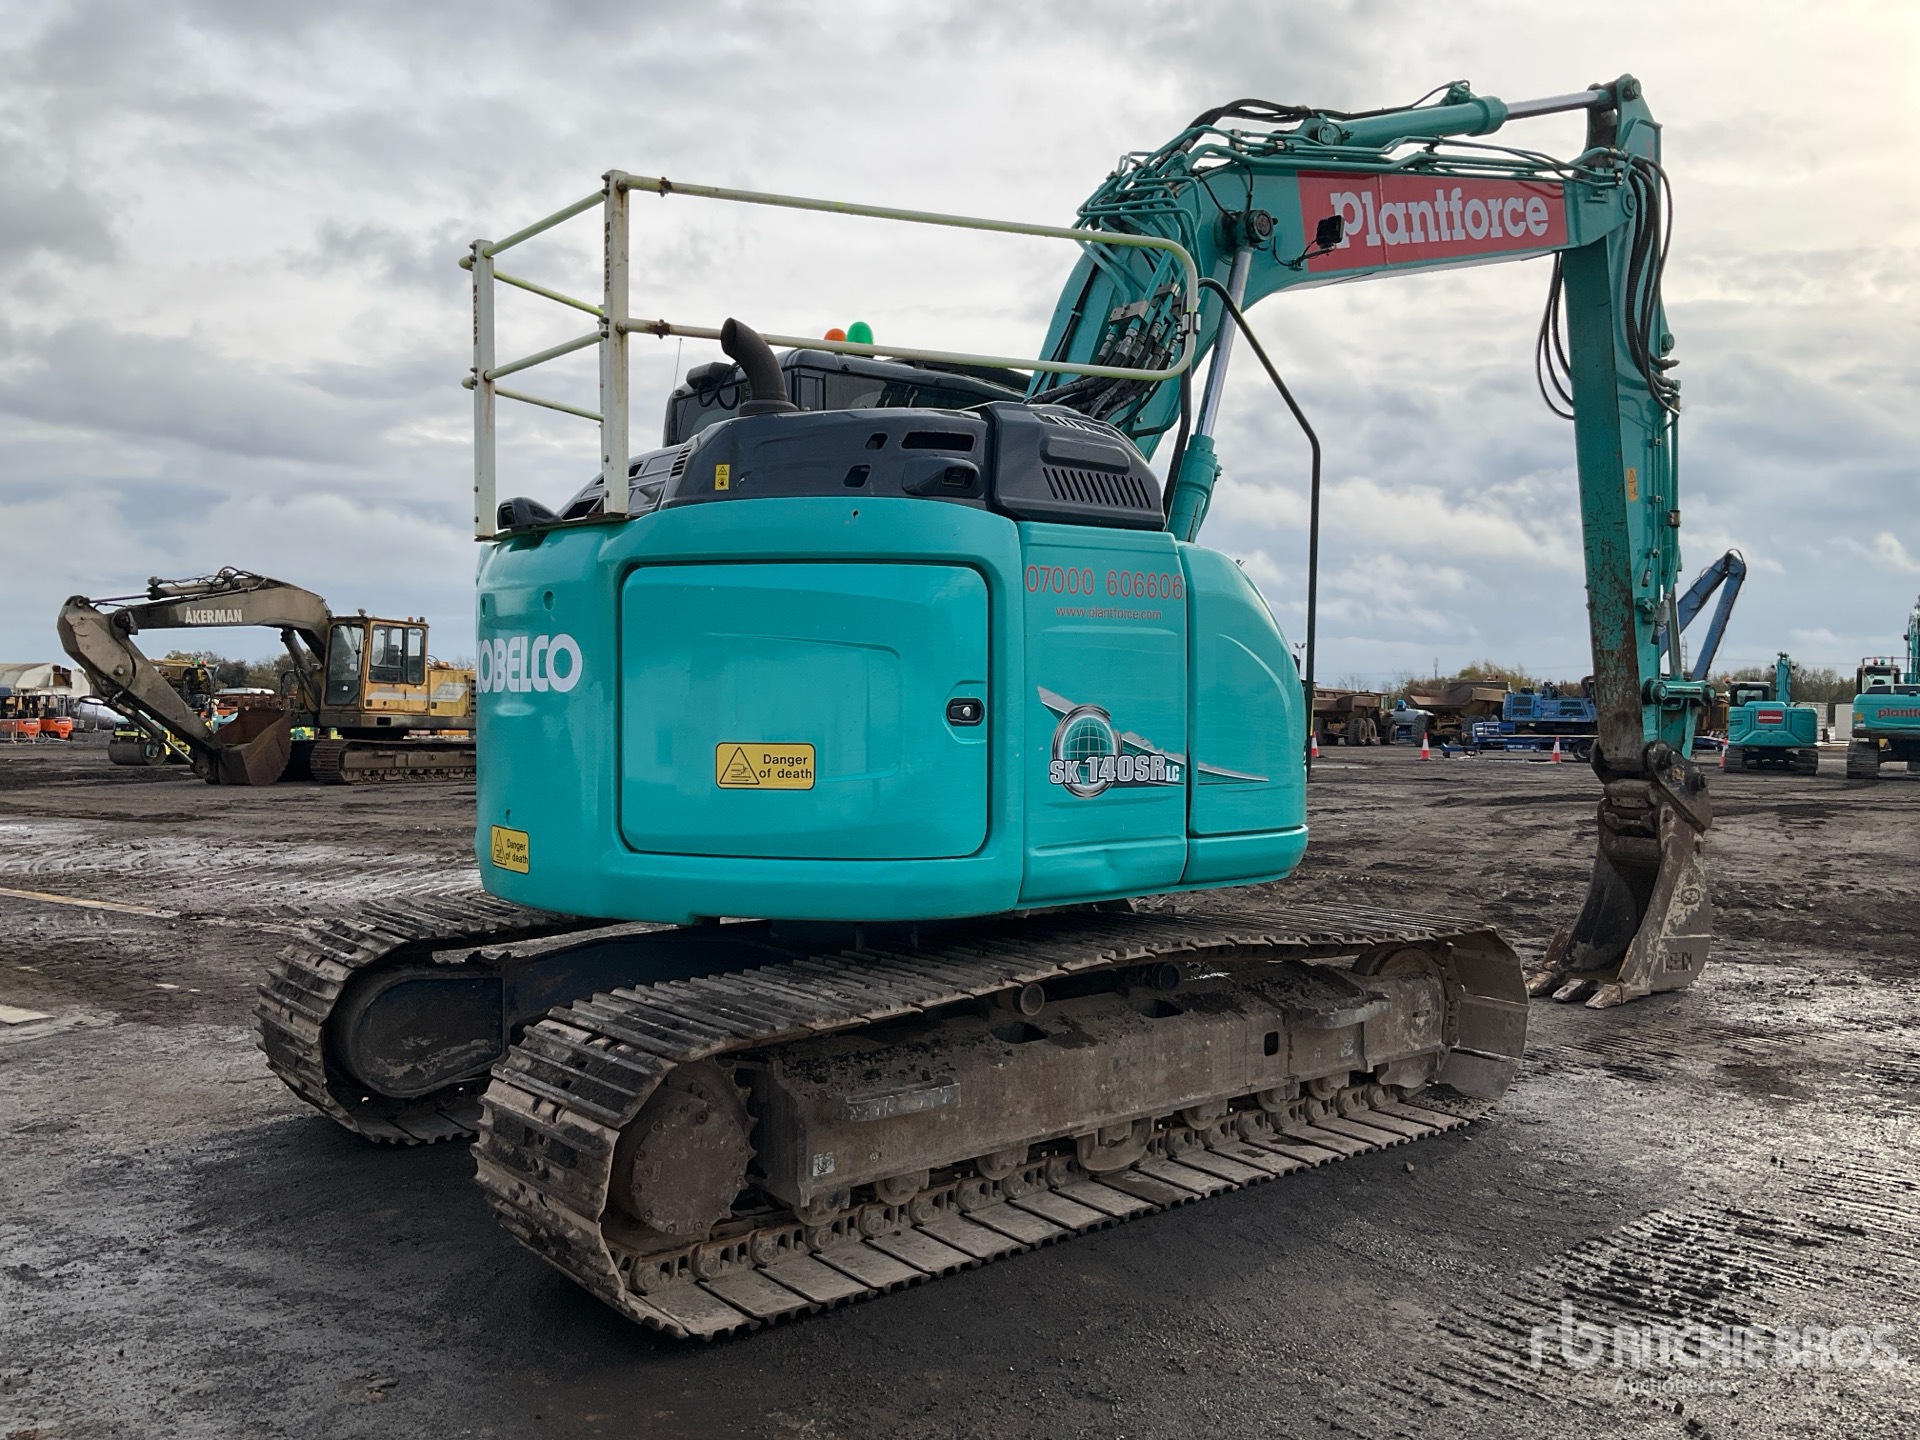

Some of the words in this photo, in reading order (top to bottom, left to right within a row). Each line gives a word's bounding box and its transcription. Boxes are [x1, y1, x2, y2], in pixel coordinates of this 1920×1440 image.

[1025, 565, 1095, 595] 07000
[1106, 570, 1184, 600] 606606
[184, 606, 243, 624] ÅKERMAN
[1055, 606, 1162, 620] www.plantforce.com
[763, 753, 808, 767] Danger
[758, 768, 771, 779] of
[777, 768, 813, 779] death
[1049, 759, 1081, 784] SK
[506, 838, 526, 852] Danger
[512, 853, 528, 864] death
